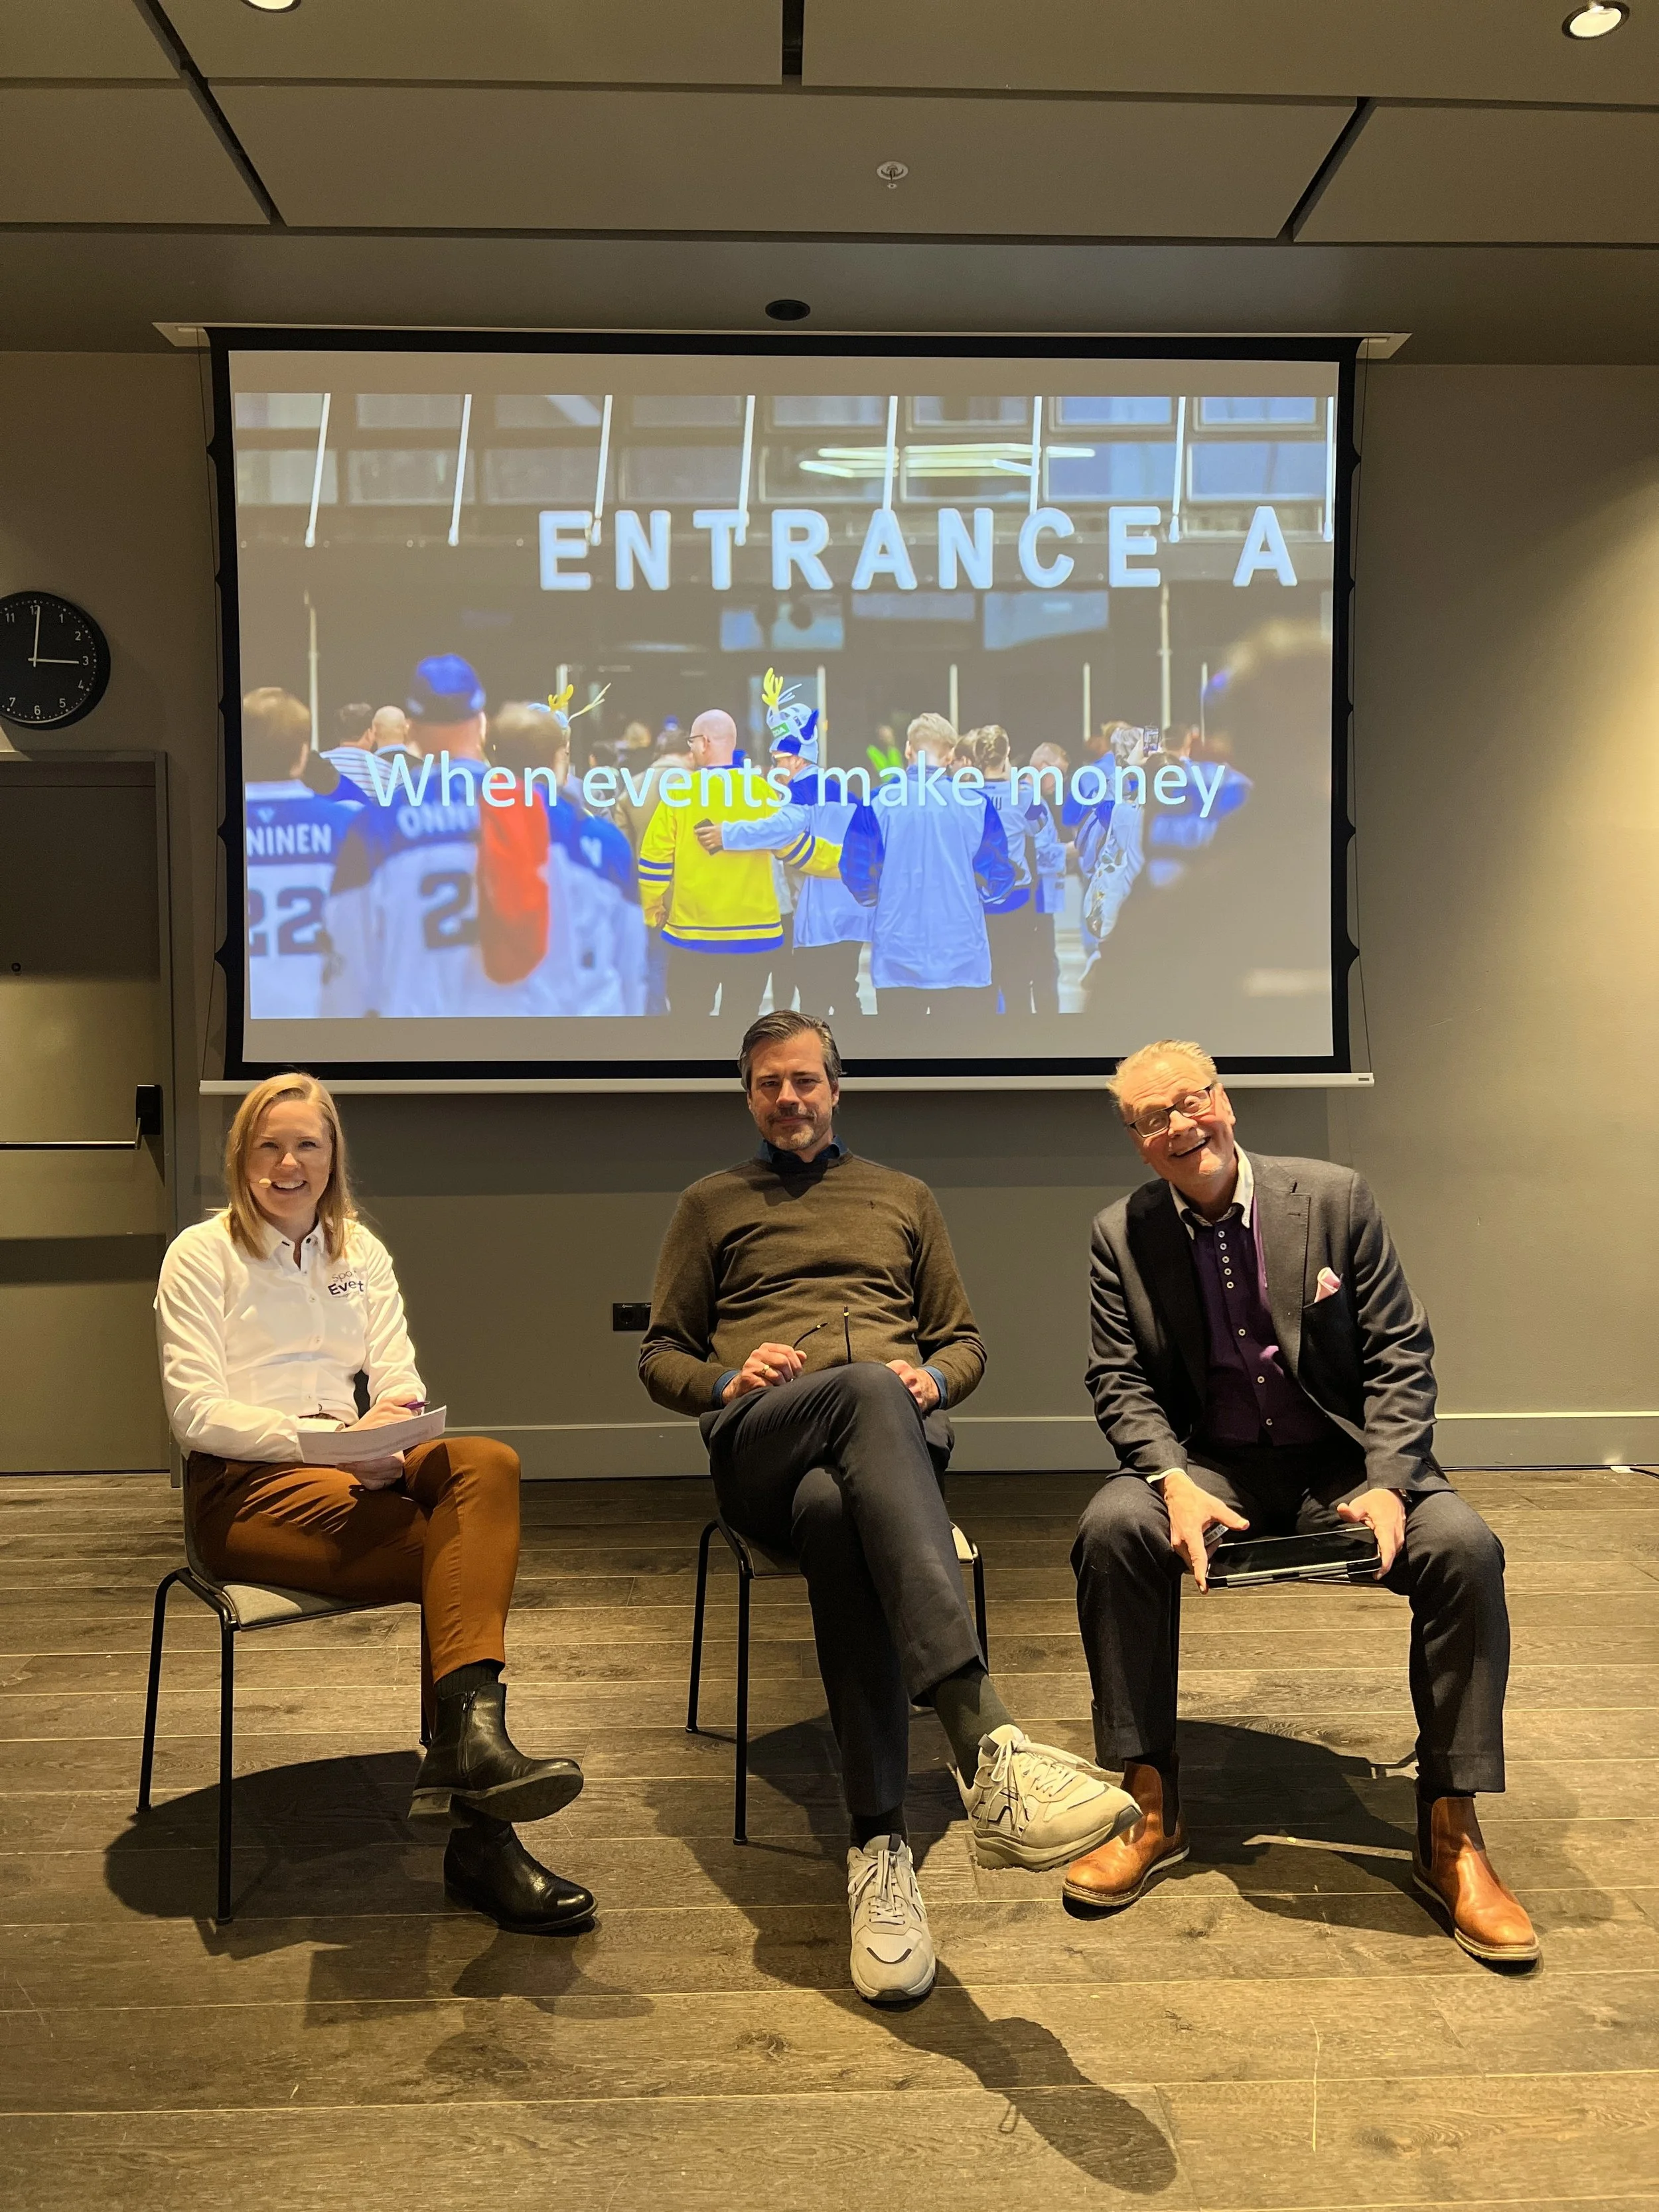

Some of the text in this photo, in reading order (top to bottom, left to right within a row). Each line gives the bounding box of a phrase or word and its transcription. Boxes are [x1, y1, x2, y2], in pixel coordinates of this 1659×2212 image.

[538, 506, 1298, 591] ENTRANCE A
[5, 612, 15, 623] 11
[59, 613, 64, 623] 1
[74, 631, 82, 641] 2
[82, 656, 90, 666] 3
[78, 680, 84, 690] 4
[9, 697, 16, 707] 7
[58, 698, 66, 708] 5
[34, 705, 41, 715] 6
[365, 750, 1226, 818] When events make money
